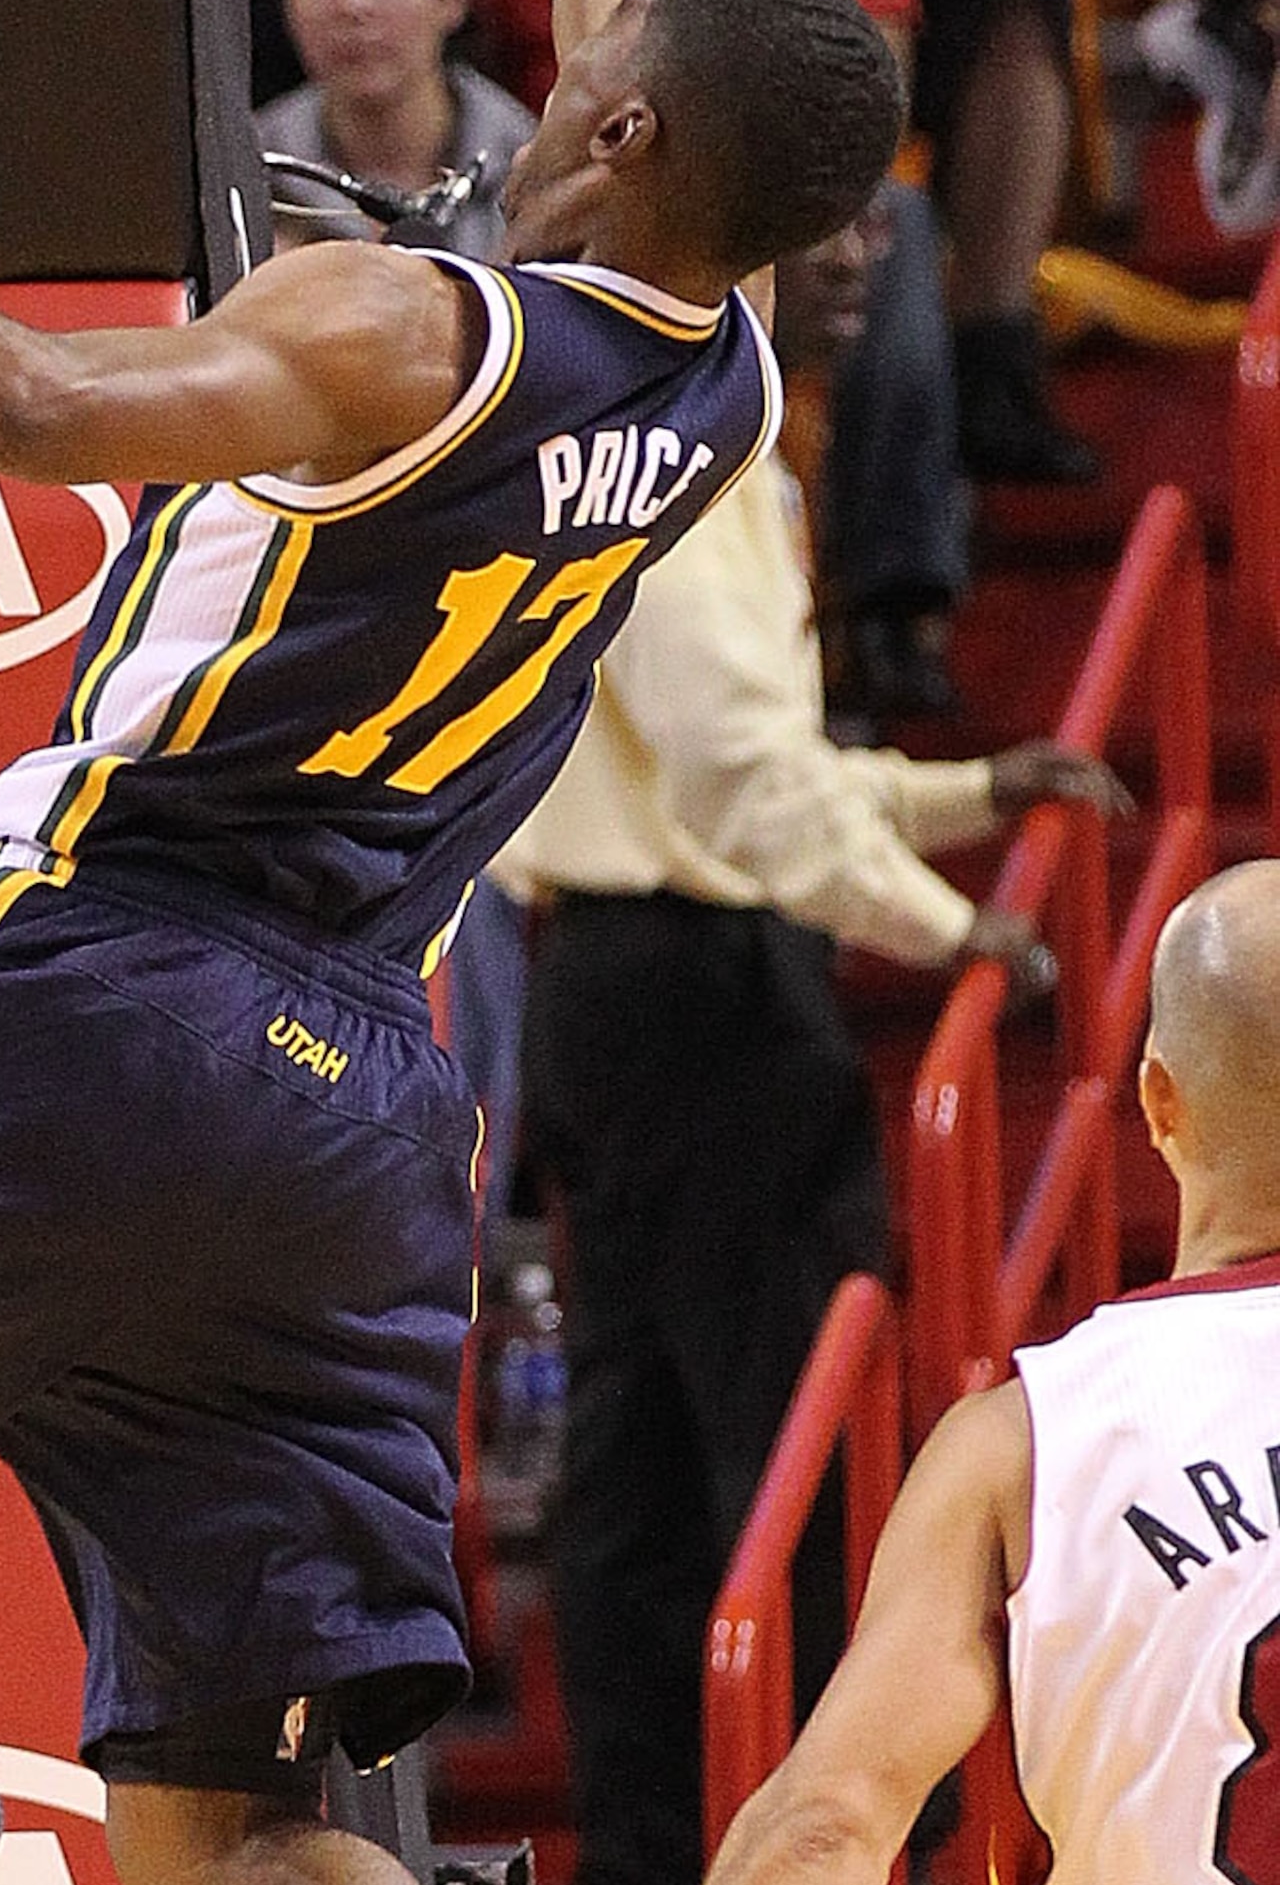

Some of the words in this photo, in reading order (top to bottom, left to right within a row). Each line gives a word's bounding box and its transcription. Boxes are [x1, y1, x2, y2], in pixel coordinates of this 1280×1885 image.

[297, 537, 650, 795] 17
[266, 1014, 350, 1084] UTAH
[1123, 1445, 1280, 1593] AR
